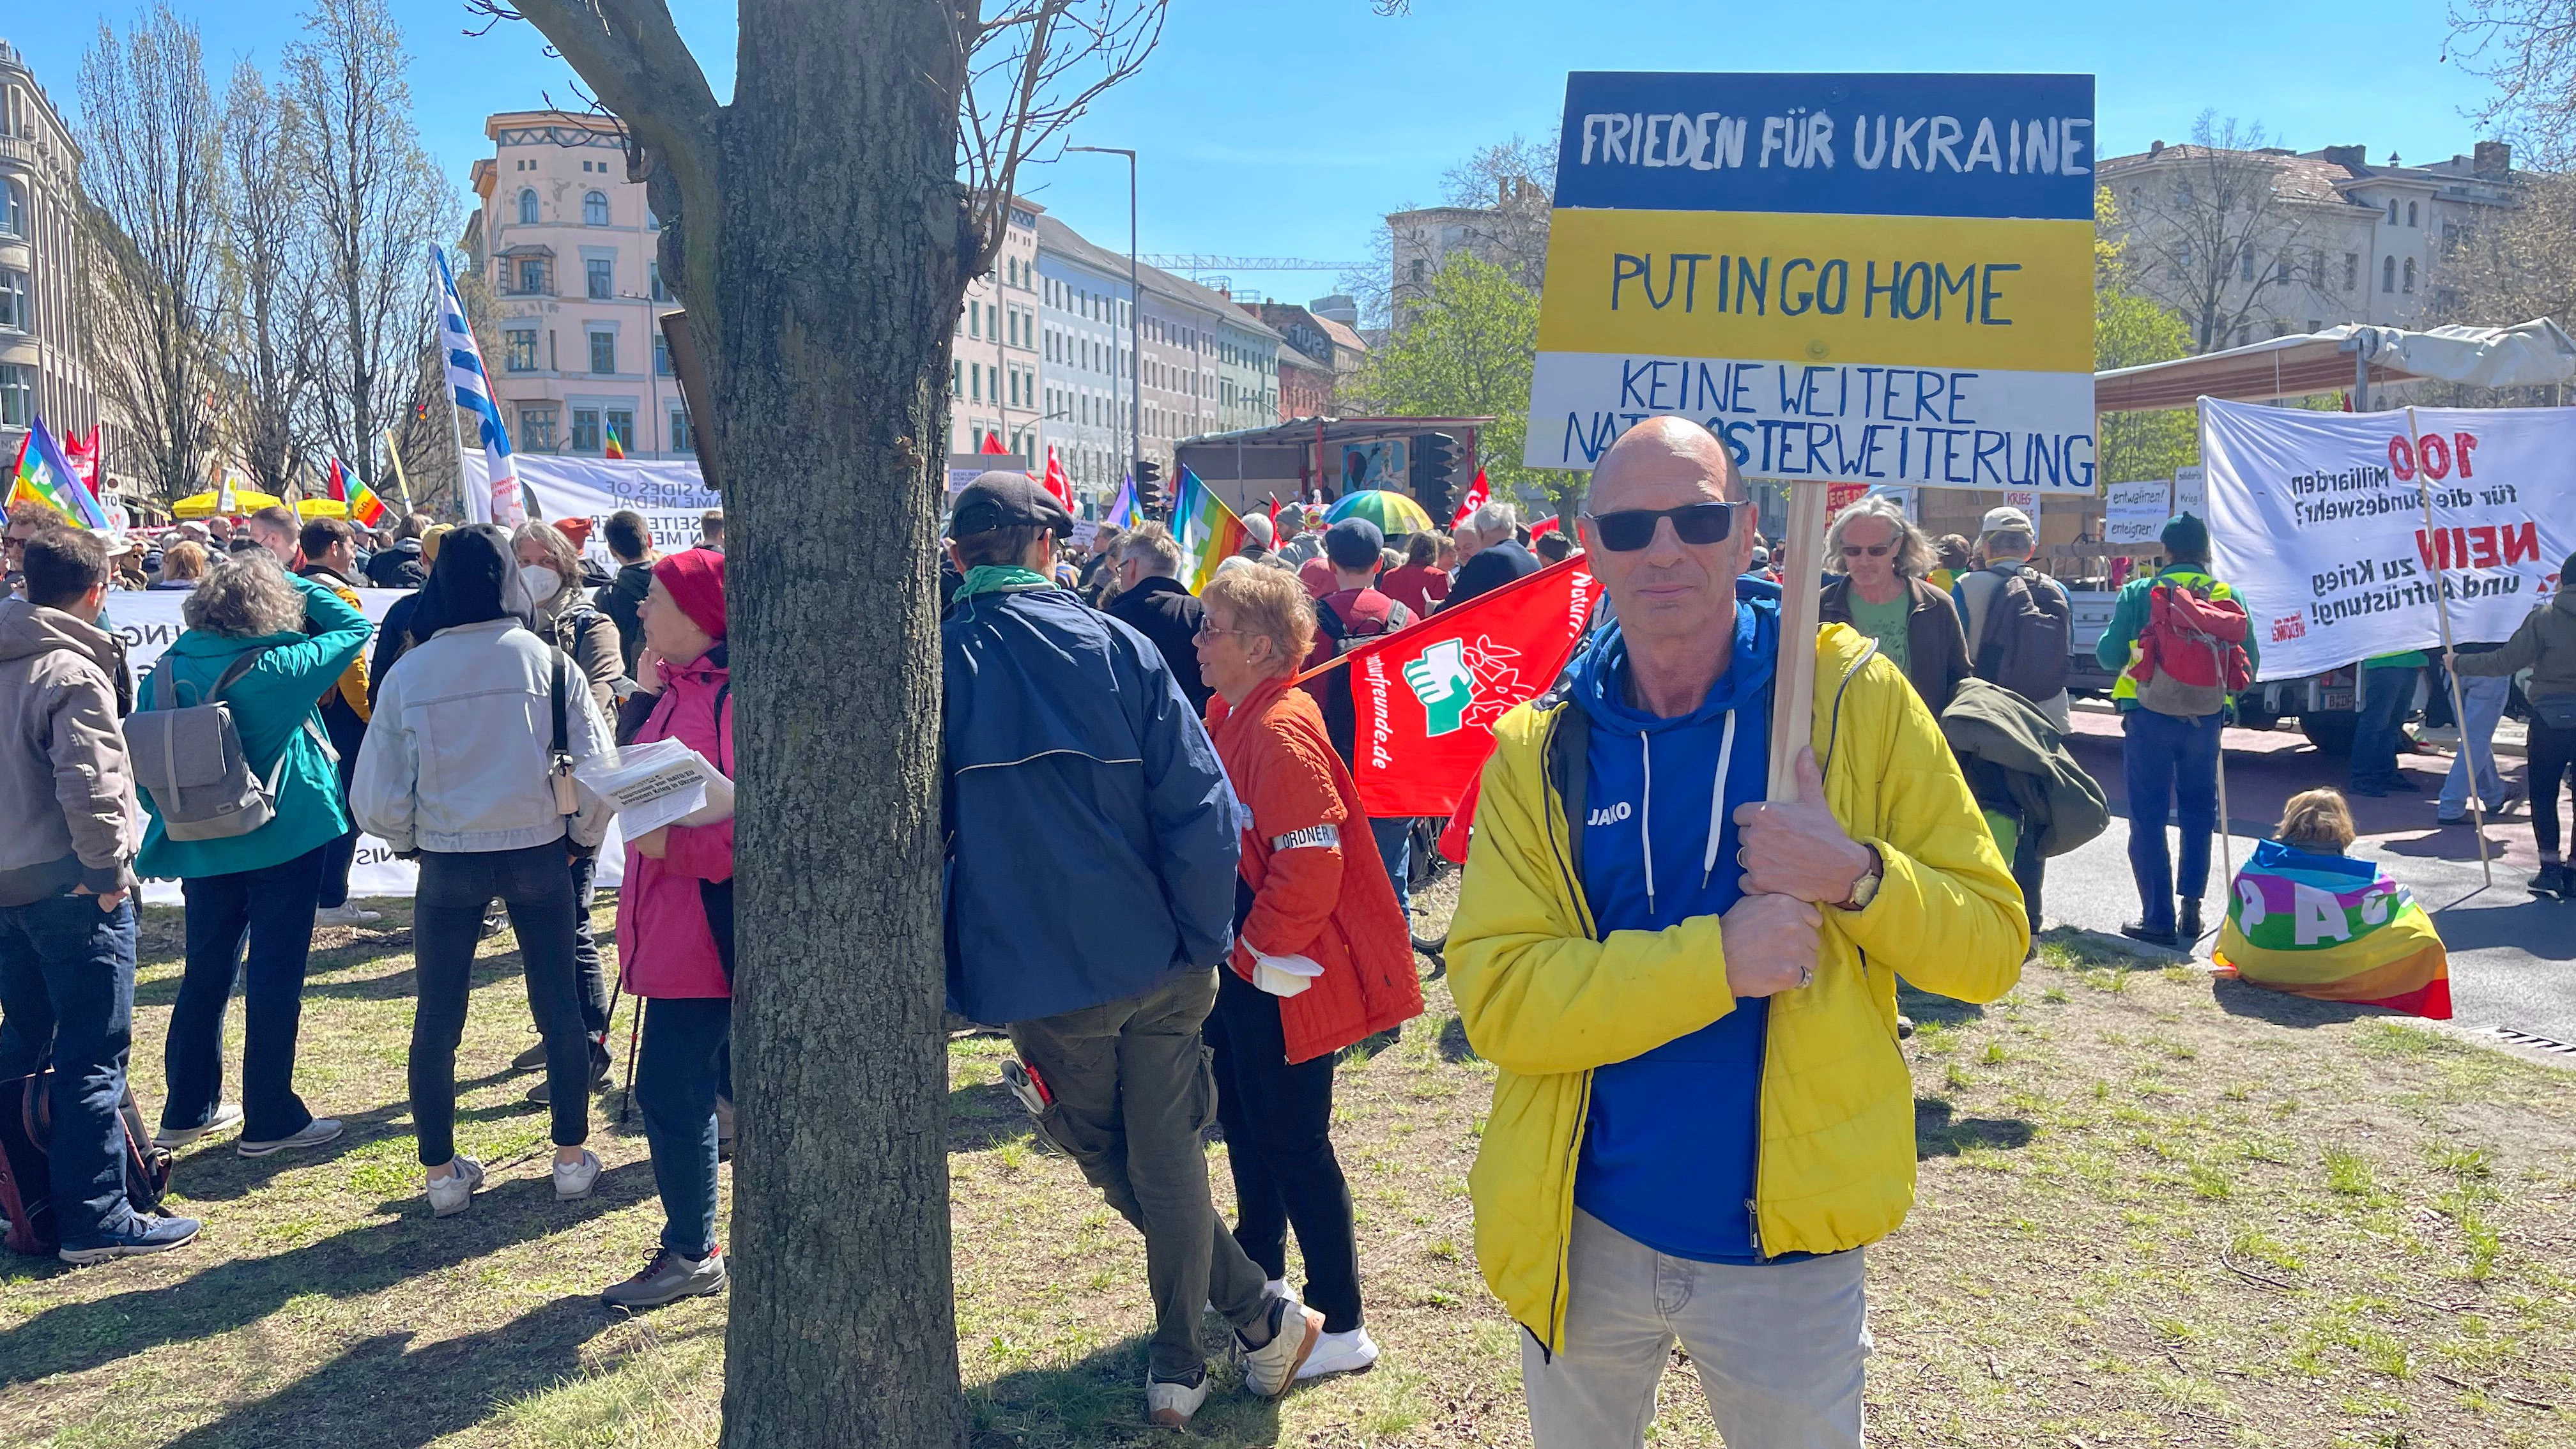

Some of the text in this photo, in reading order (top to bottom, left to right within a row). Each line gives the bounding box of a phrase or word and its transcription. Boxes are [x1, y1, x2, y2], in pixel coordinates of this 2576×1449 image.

[1581, 106, 2093, 176] FRIEDEN FÜR UKRAINE
[1612, 253, 2022, 325] PUTIN GO HOME
[1621, 360, 1979, 424] KEINE WEITERE
[2007, 493, 2032, 505] KRIEG
[2112, 521, 2157, 538] enteignen!
[652, 785, 671, 795] Krieg
[677, 774, 704, 786] Ukraine
[666, 770, 695, 783] NATO/EU
[1587, 801, 1632, 825] JAKO
